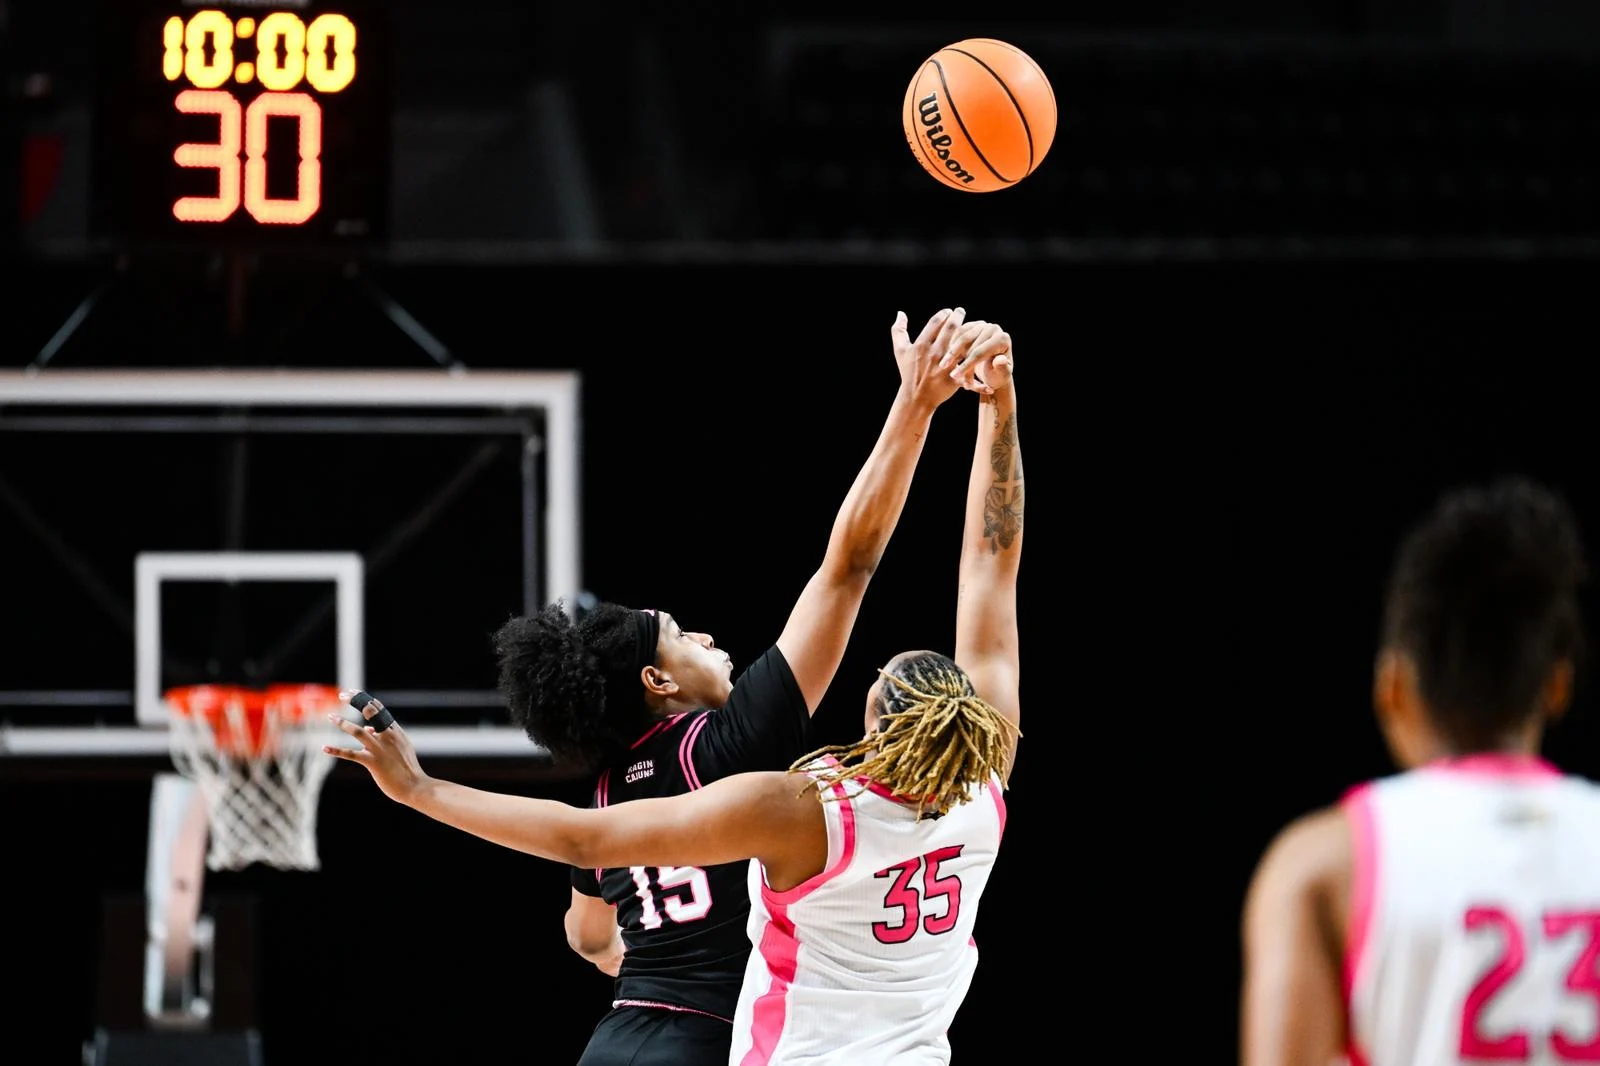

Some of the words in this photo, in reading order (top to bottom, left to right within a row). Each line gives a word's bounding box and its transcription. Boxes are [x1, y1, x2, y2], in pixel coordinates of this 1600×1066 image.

[163, 10, 356, 93] 10:00
[173, 90, 321, 224] 30
[918, 91, 976, 184] Wilson
[625, 768, 655, 784] CAJUNS
[629, 865, 713, 930] 15
[871, 844, 965, 945] 35
[1459, 905, 1600, 1061] 23
